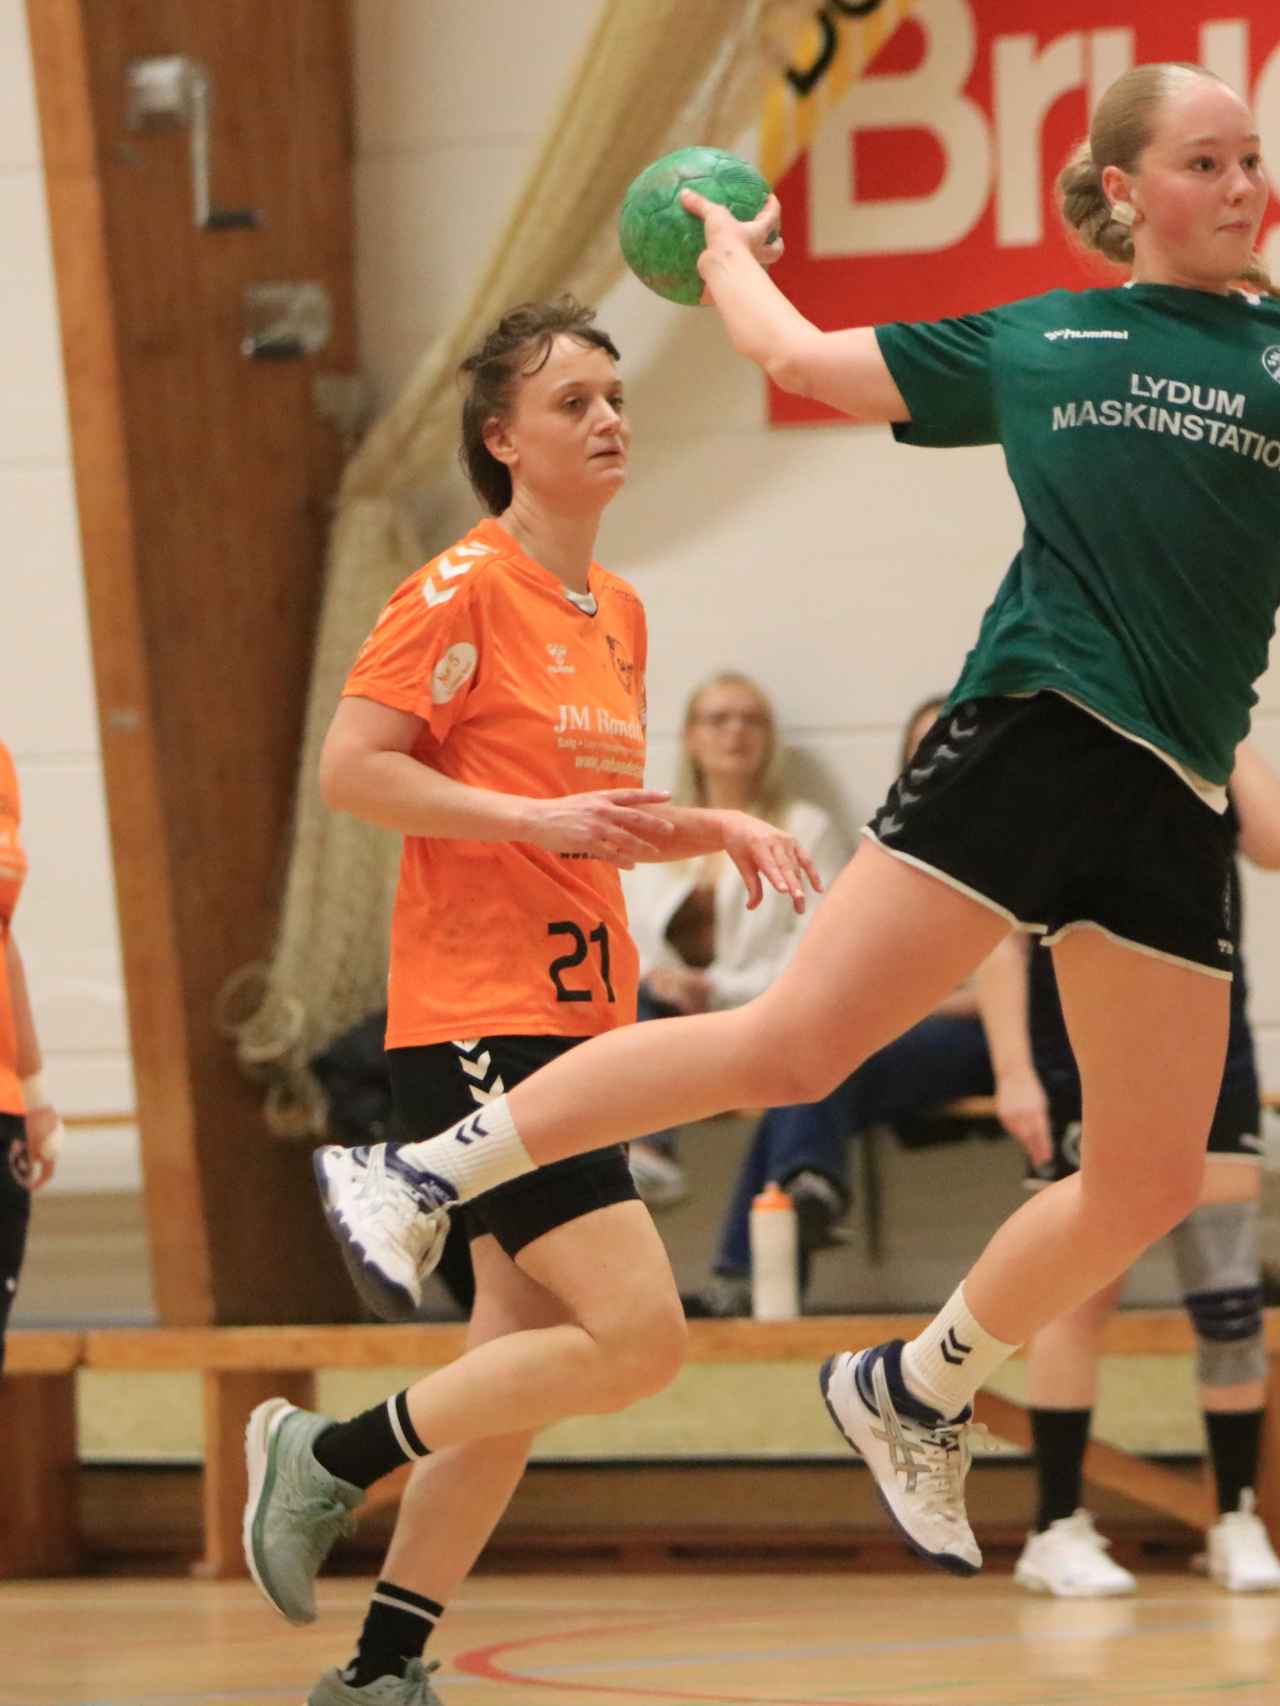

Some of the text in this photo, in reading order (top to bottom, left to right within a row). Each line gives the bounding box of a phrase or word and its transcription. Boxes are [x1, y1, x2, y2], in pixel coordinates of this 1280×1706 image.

[1130, 373, 1246, 418] LYDUM
[553, 704, 590, 733] JM
[547, 921, 616, 1003] 21
